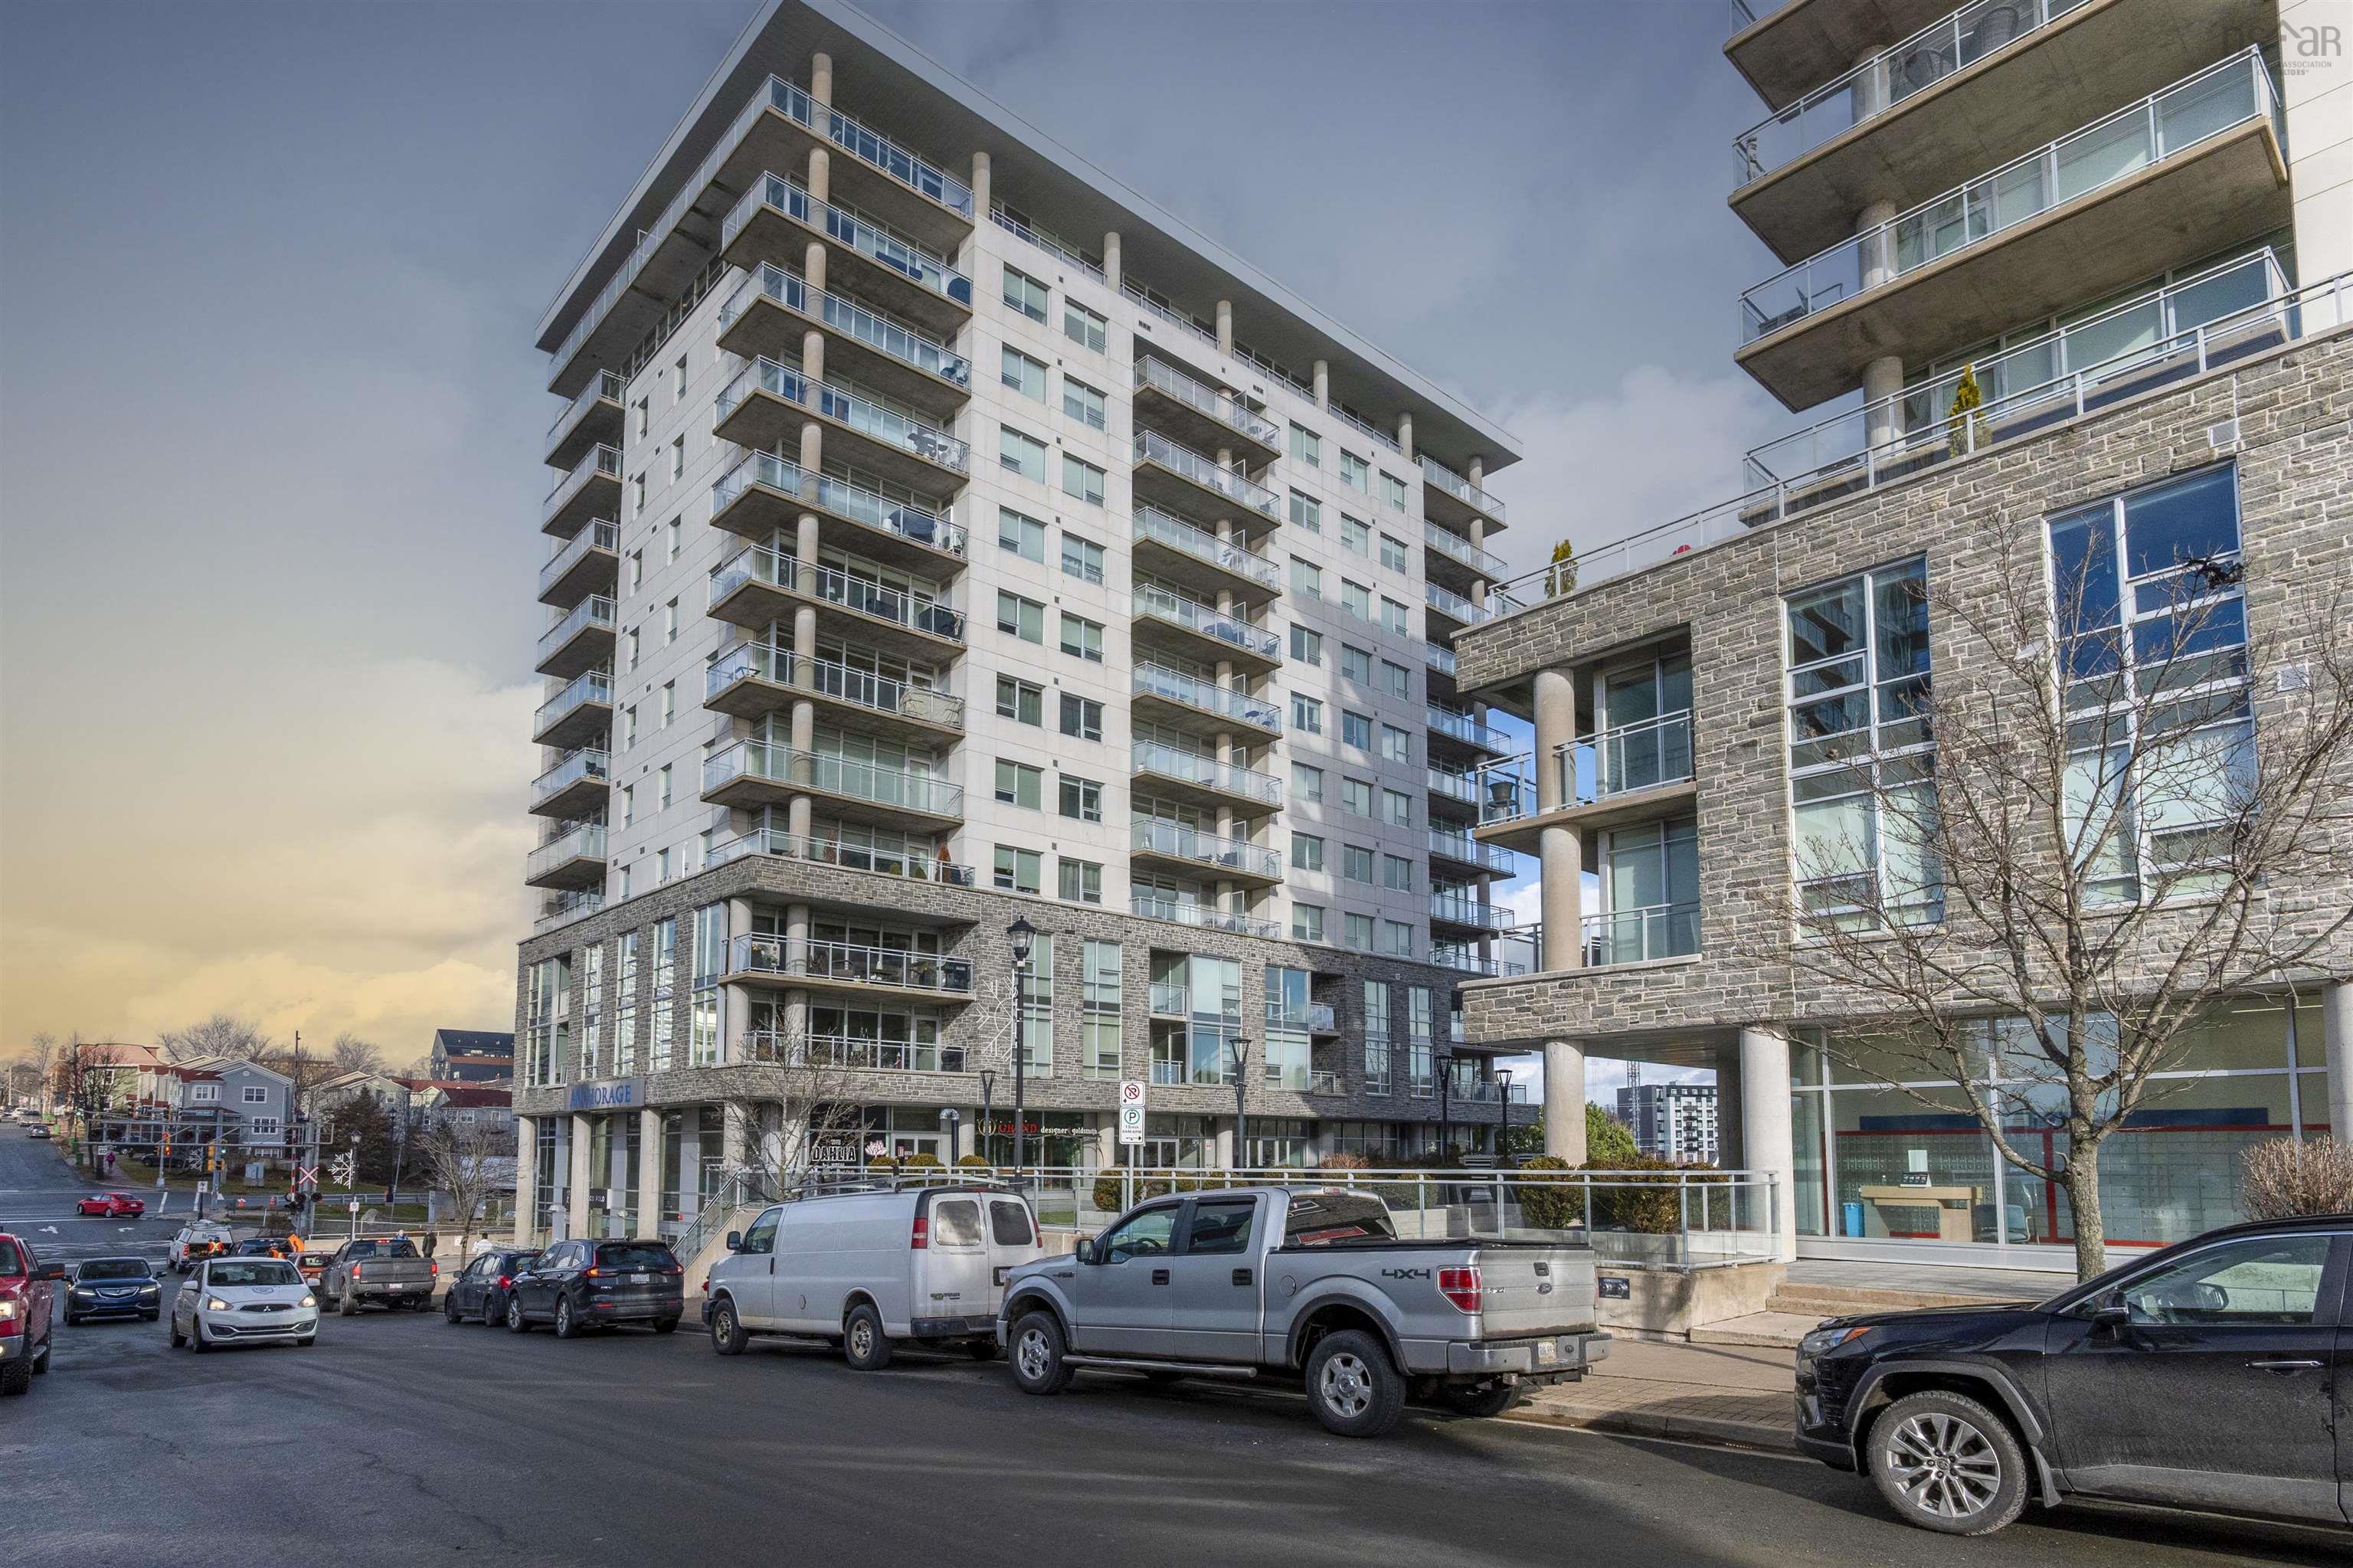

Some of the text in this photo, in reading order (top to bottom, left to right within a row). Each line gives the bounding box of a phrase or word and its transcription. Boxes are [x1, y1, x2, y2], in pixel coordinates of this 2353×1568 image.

[998, 1121, 1098, 1136] GRND designer goldsmith
[812, 1146, 856, 1162] DAHLIA
[1381, 1268, 1431, 1279] 4X4
